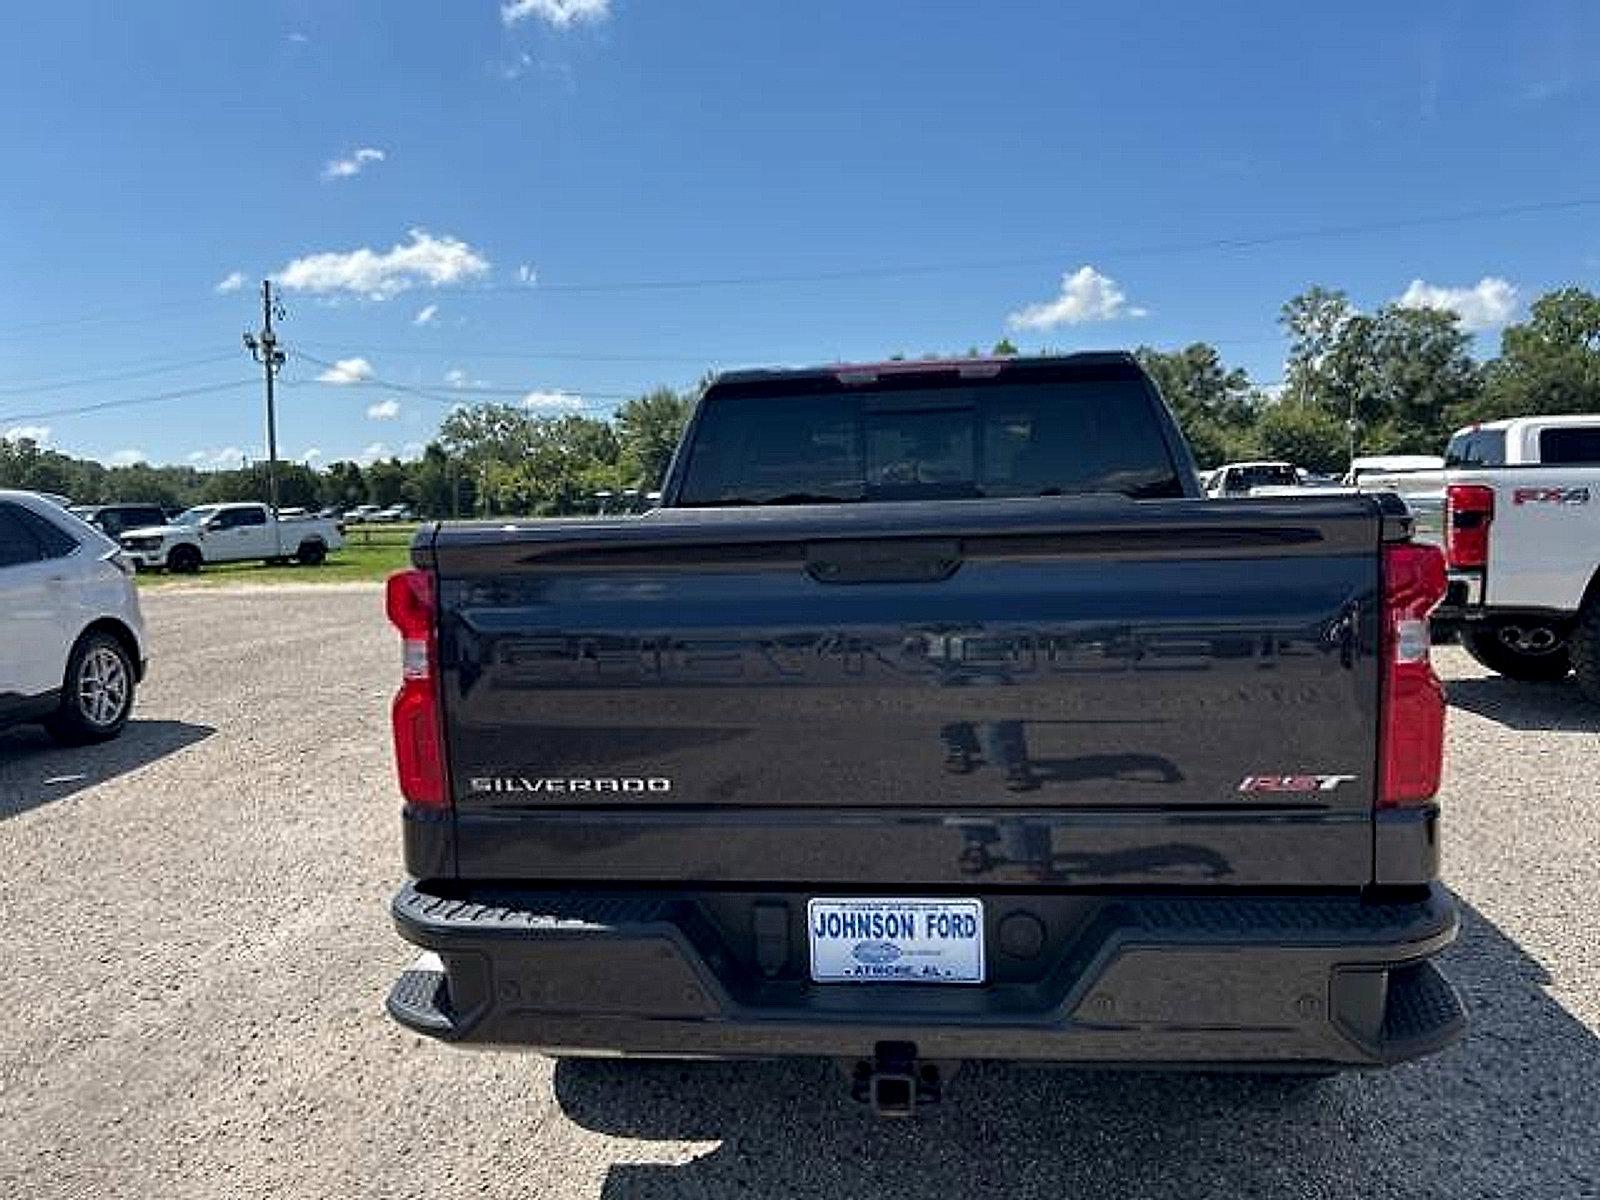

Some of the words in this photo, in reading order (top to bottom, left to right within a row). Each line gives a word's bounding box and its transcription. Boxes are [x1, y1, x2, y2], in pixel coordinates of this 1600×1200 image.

[470, 777, 672, 792] SILVERADO
[815, 912, 914, 939] JOHNSON
[926, 913, 976, 939] FORD
